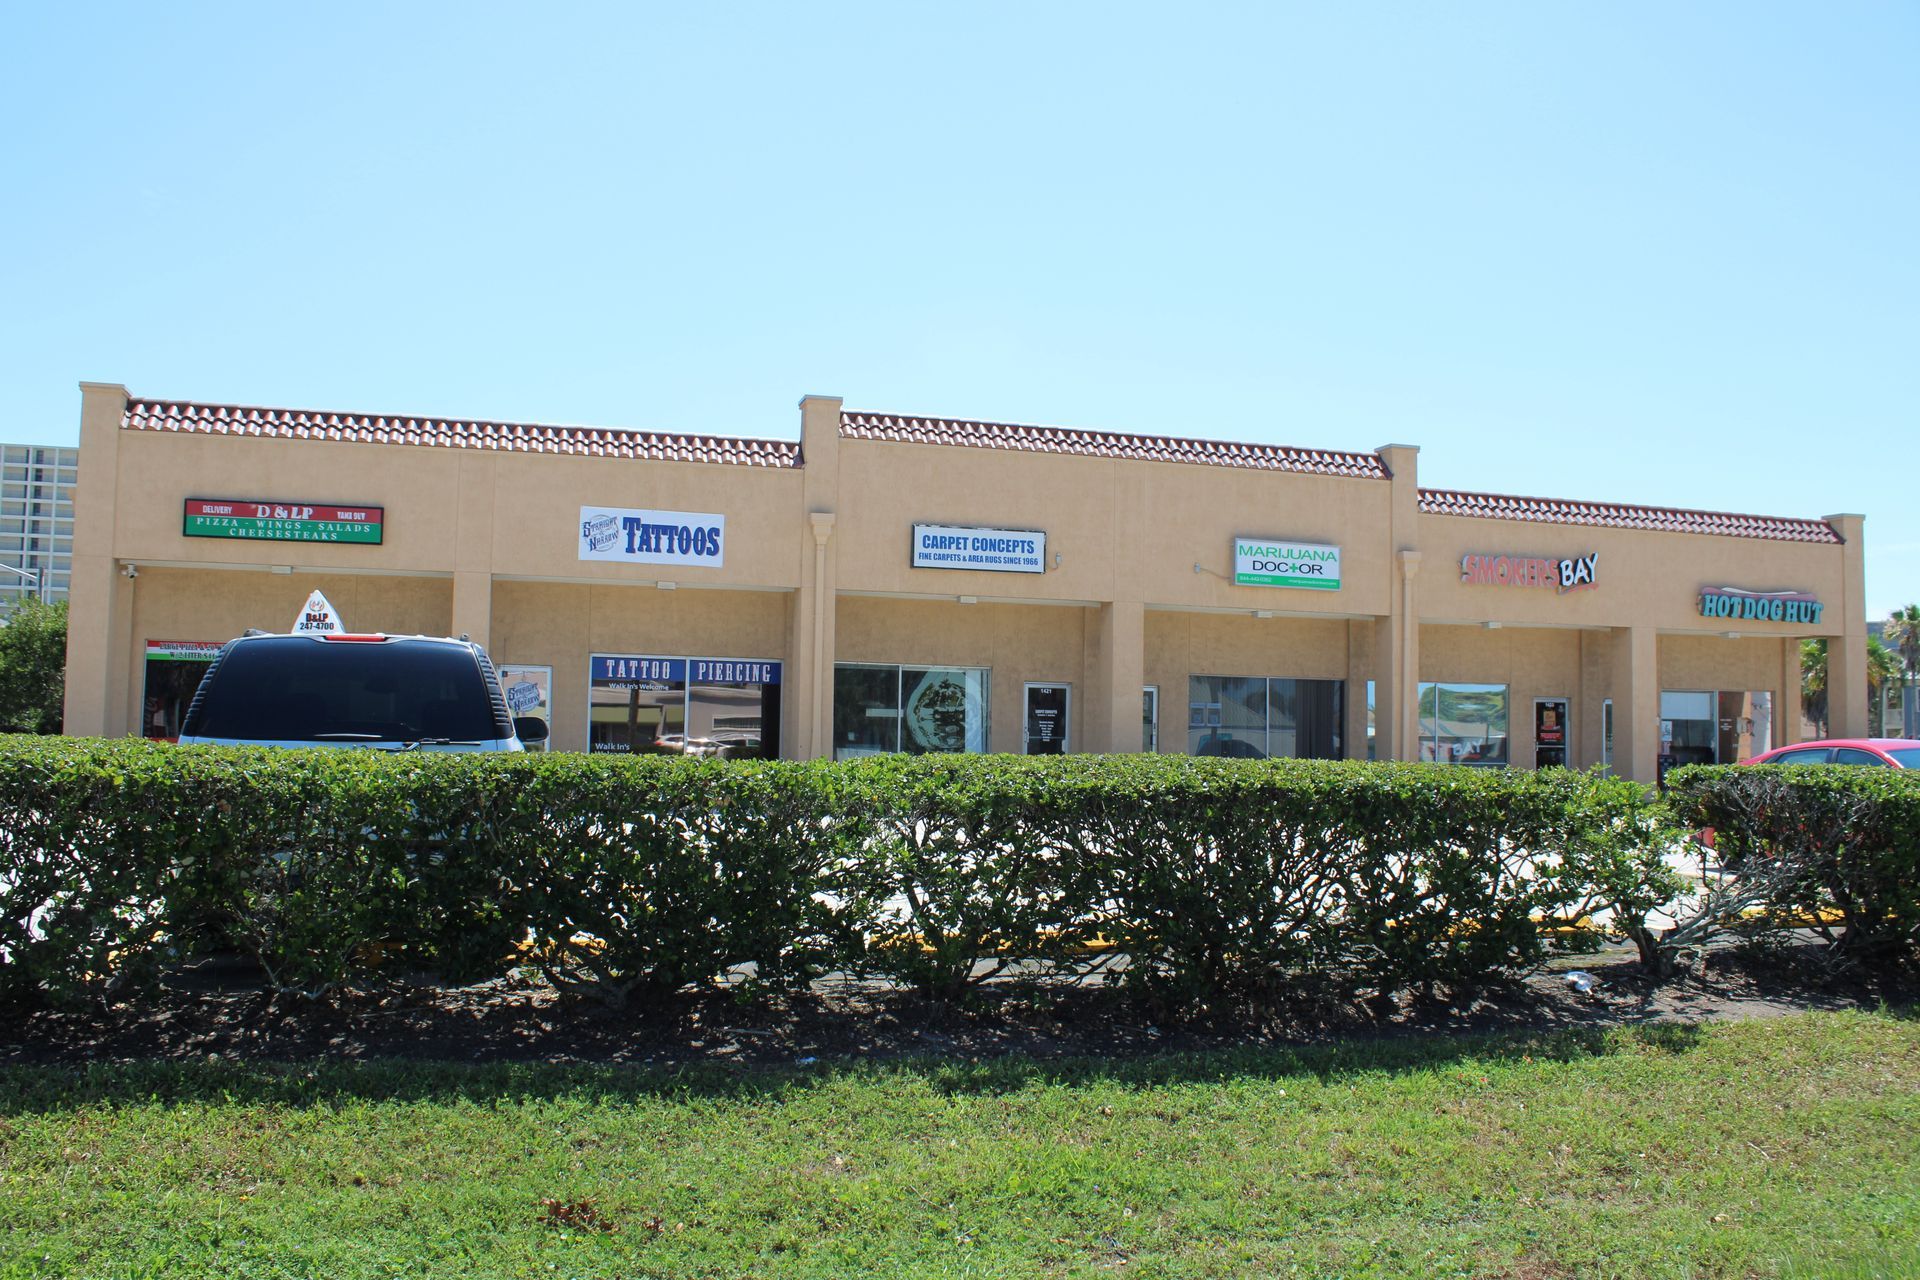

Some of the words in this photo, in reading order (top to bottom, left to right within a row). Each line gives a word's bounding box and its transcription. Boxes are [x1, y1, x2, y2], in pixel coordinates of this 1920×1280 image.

[202, 505, 232, 514] DELIVERY
[196, 517, 238, 527] PIZZA
[256, 519, 301, 530] WINGS
[318, 521, 371, 533] SALADS
[229, 528, 337, 541] CHEESESTEAKS
[623, 516, 720, 556] TATTOOS
[922, 534, 969, 551] CARPET
[971, 537, 1035, 554] CONCEPTS
[918, 552, 932, 560] FINE
[933, 552, 961, 562] CARPETS
[968, 554, 984, 563] AREA
[985, 556, 1002, 564] RUGS
[1003, 556, 1022, 565] SINCE
[1023, 557, 1039, 566] 1966
[1239, 545, 1337, 562] MARIJUANA
[1461, 554, 1560, 587] SMOKERS
[1560, 551, 1599, 587] BAY
[305, 612, 329, 623] D&LP
[1784, 600, 1824, 624] HUT
[300, 622, 335, 631] 247-4700
[606, 659, 671, 679] TATTOO
[698, 662, 771, 682] PIERCING
[608, 682, 627, 690] Walk
[639, 683, 669, 691] Welcome
[595, 742, 615, 750] Walk
